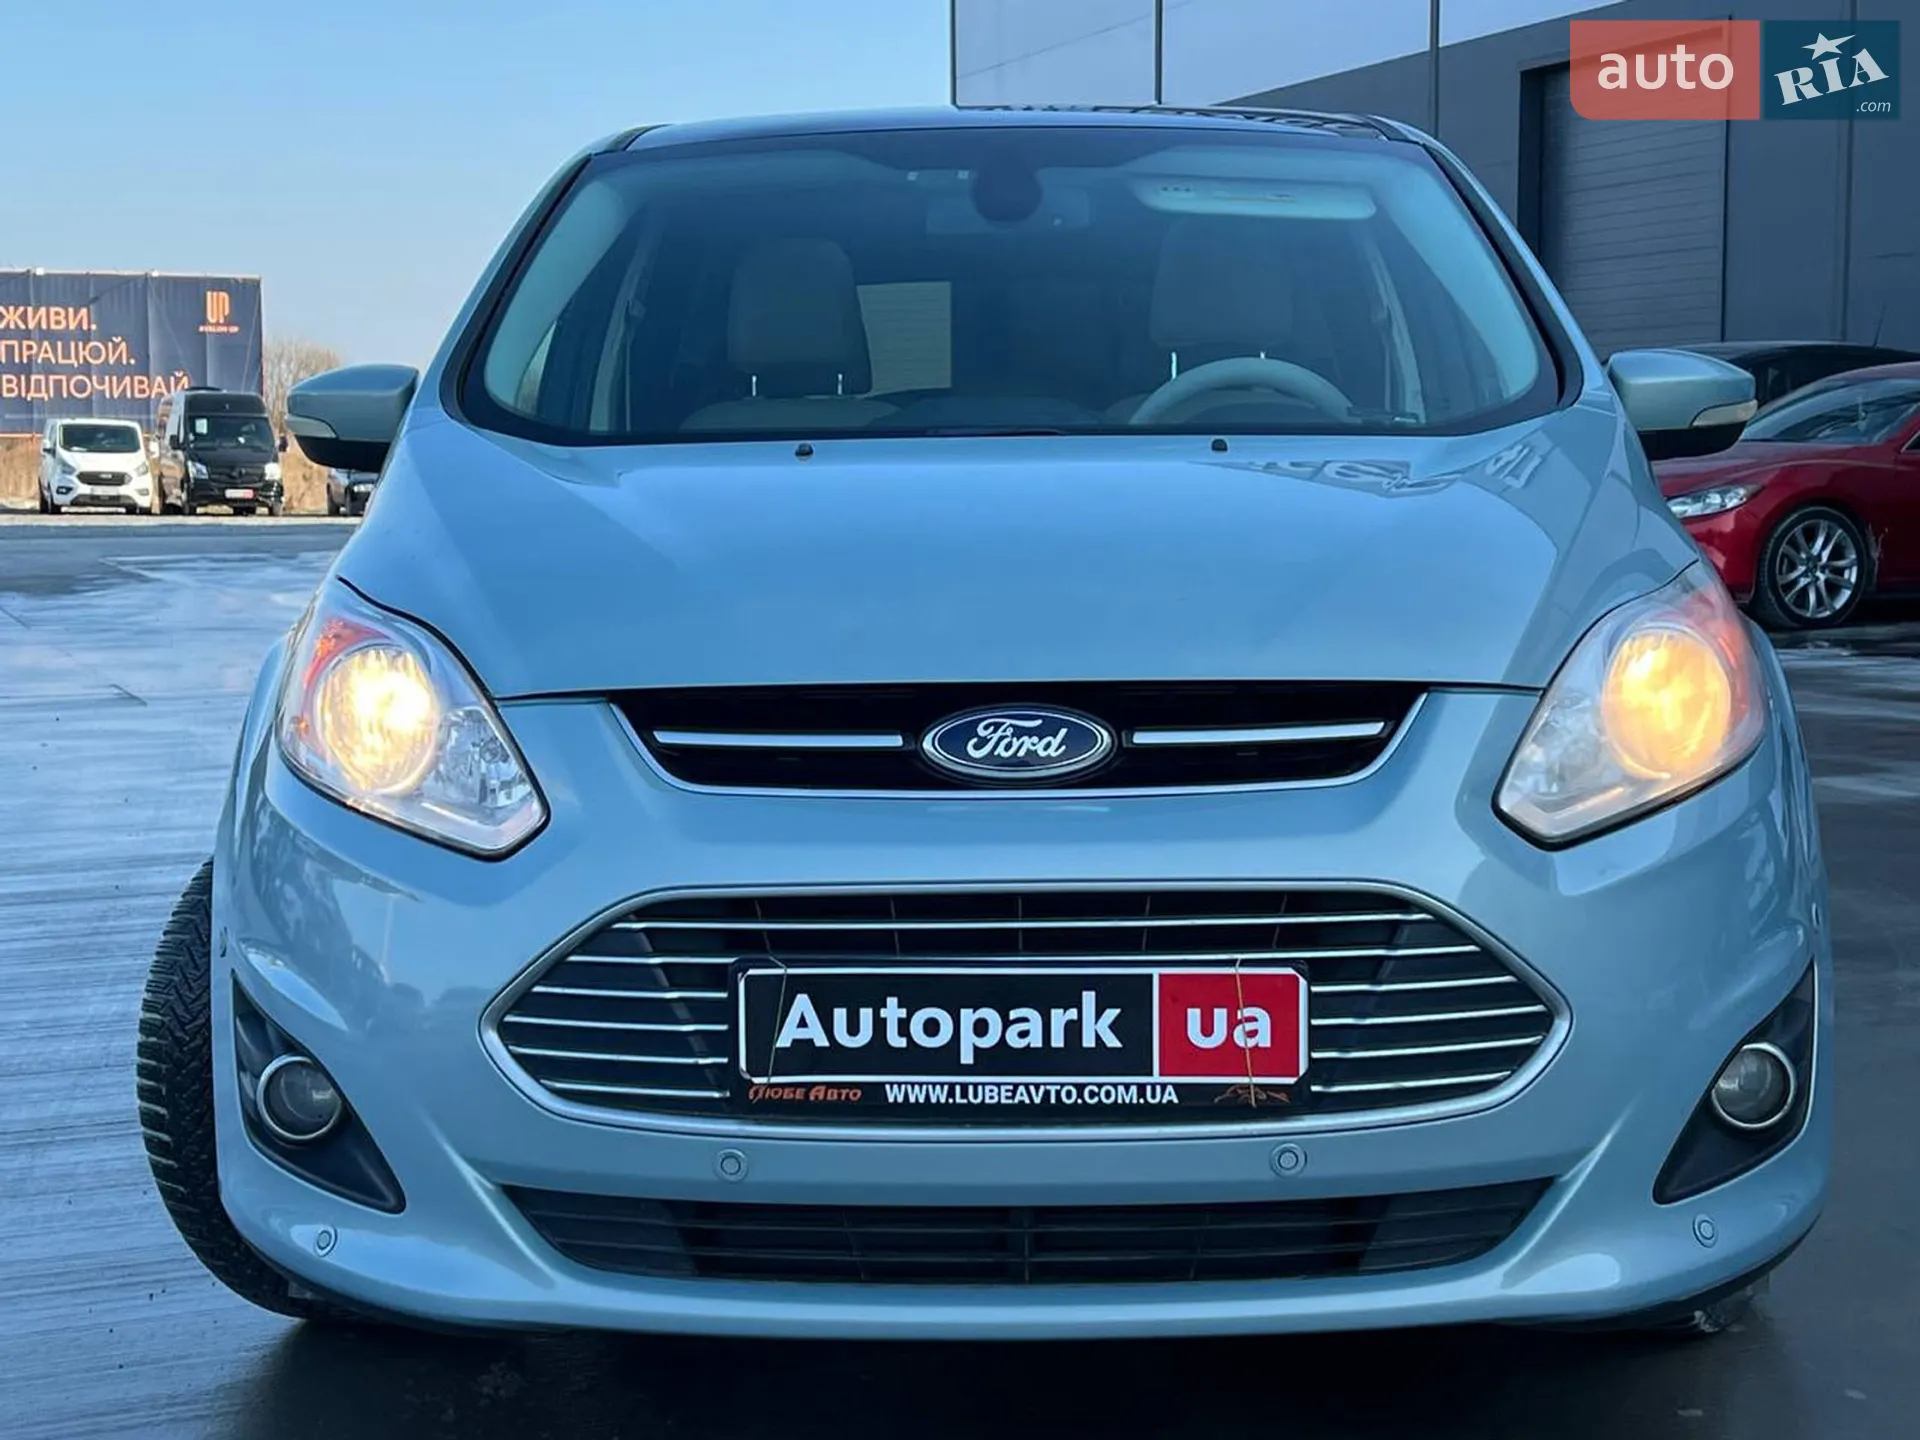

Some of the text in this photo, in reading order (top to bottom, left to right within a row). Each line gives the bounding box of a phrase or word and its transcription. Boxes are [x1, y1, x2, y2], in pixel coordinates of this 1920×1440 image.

[0, 306, 97, 331] ЖИВИ.
[0, 336, 136, 367] ПРАЦЮЙ.
[1, 371, 191, 401] ВІДПОЧИВАЙ
[966, 718, 1068, 759] Ford
[775, 990, 1272, 1065] Autopark ua
[885, 1083, 1178, 1105] WWW.LUBEAVTO.COM.UA
